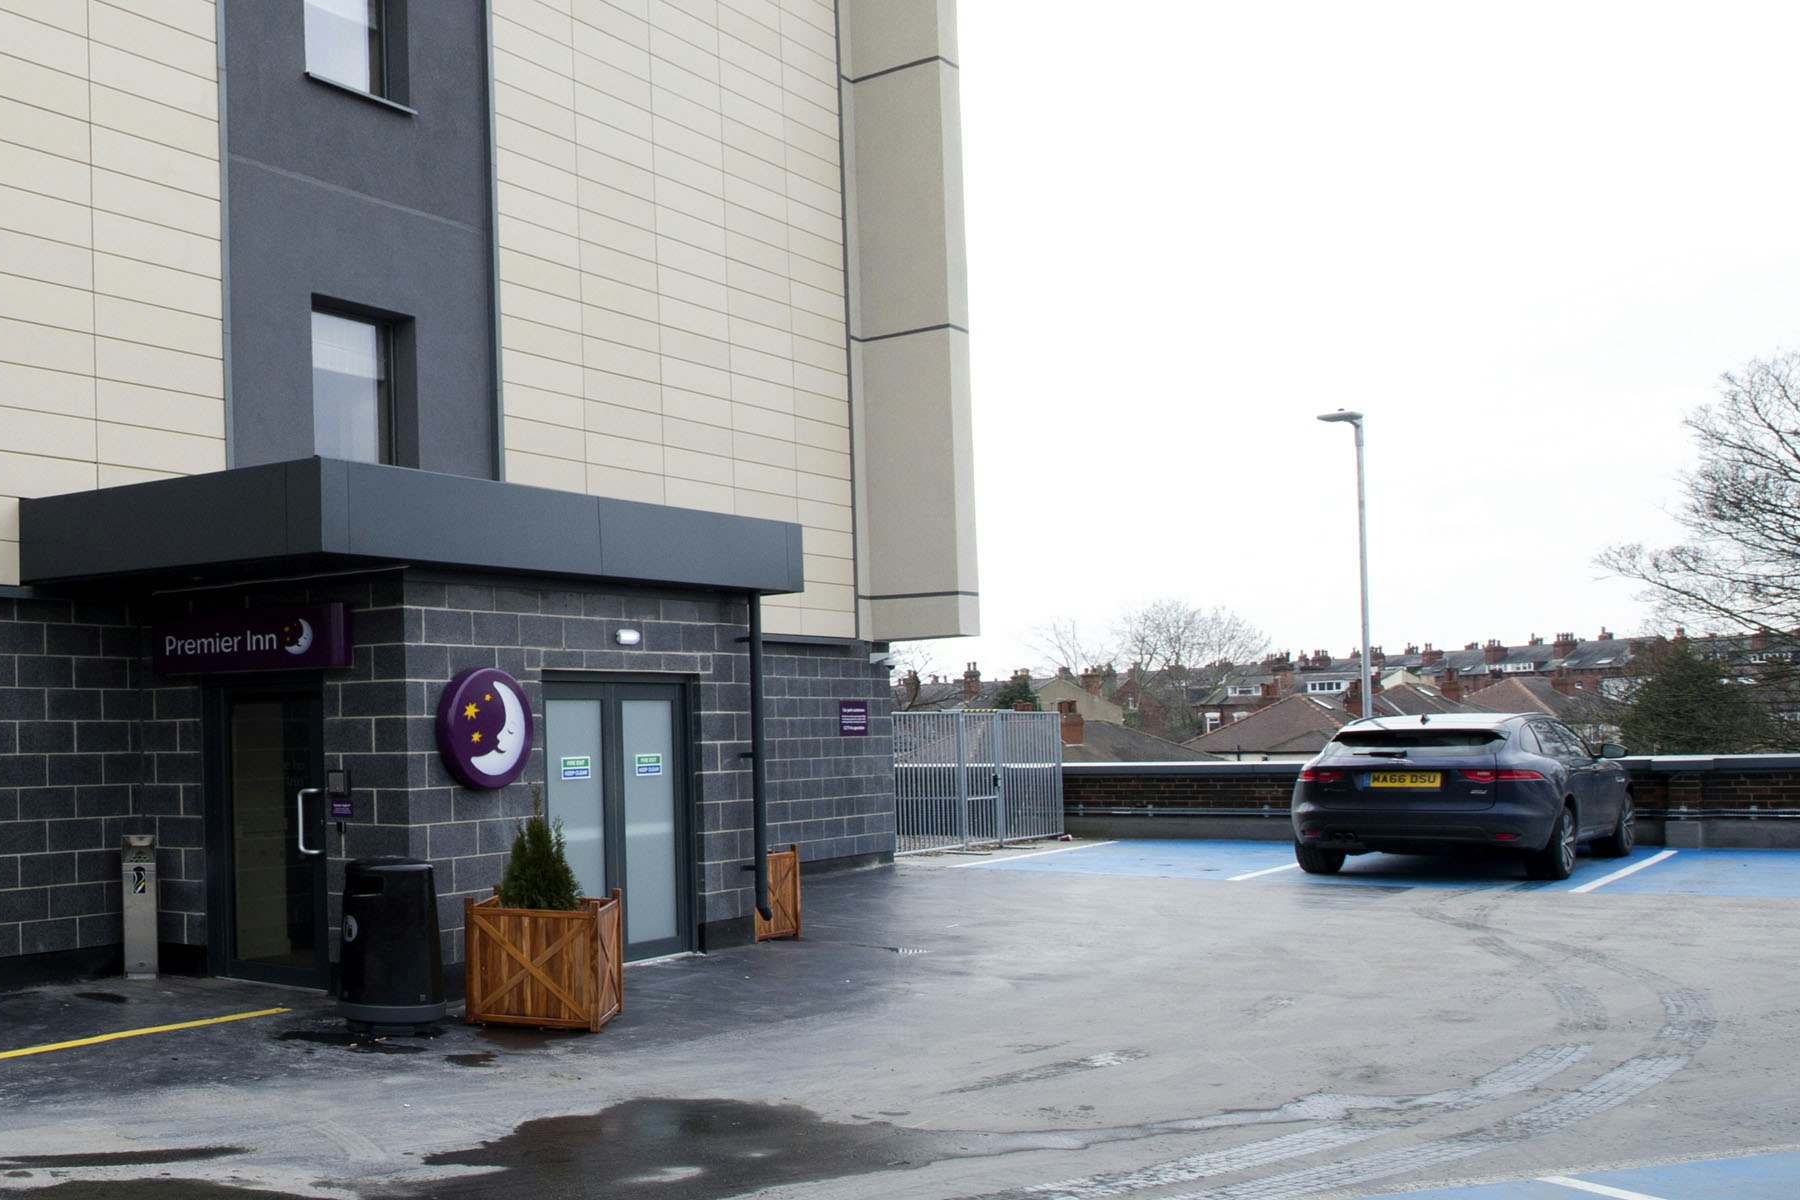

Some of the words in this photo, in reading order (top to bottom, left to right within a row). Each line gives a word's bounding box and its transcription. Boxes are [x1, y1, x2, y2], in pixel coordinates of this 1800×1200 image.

[165, 633, 242, 656] Premier
[246, 630, 277, 651] Inn
[1372, 774, 1406, 784] MA66
[1410, 774, 1436, 783] DSU
